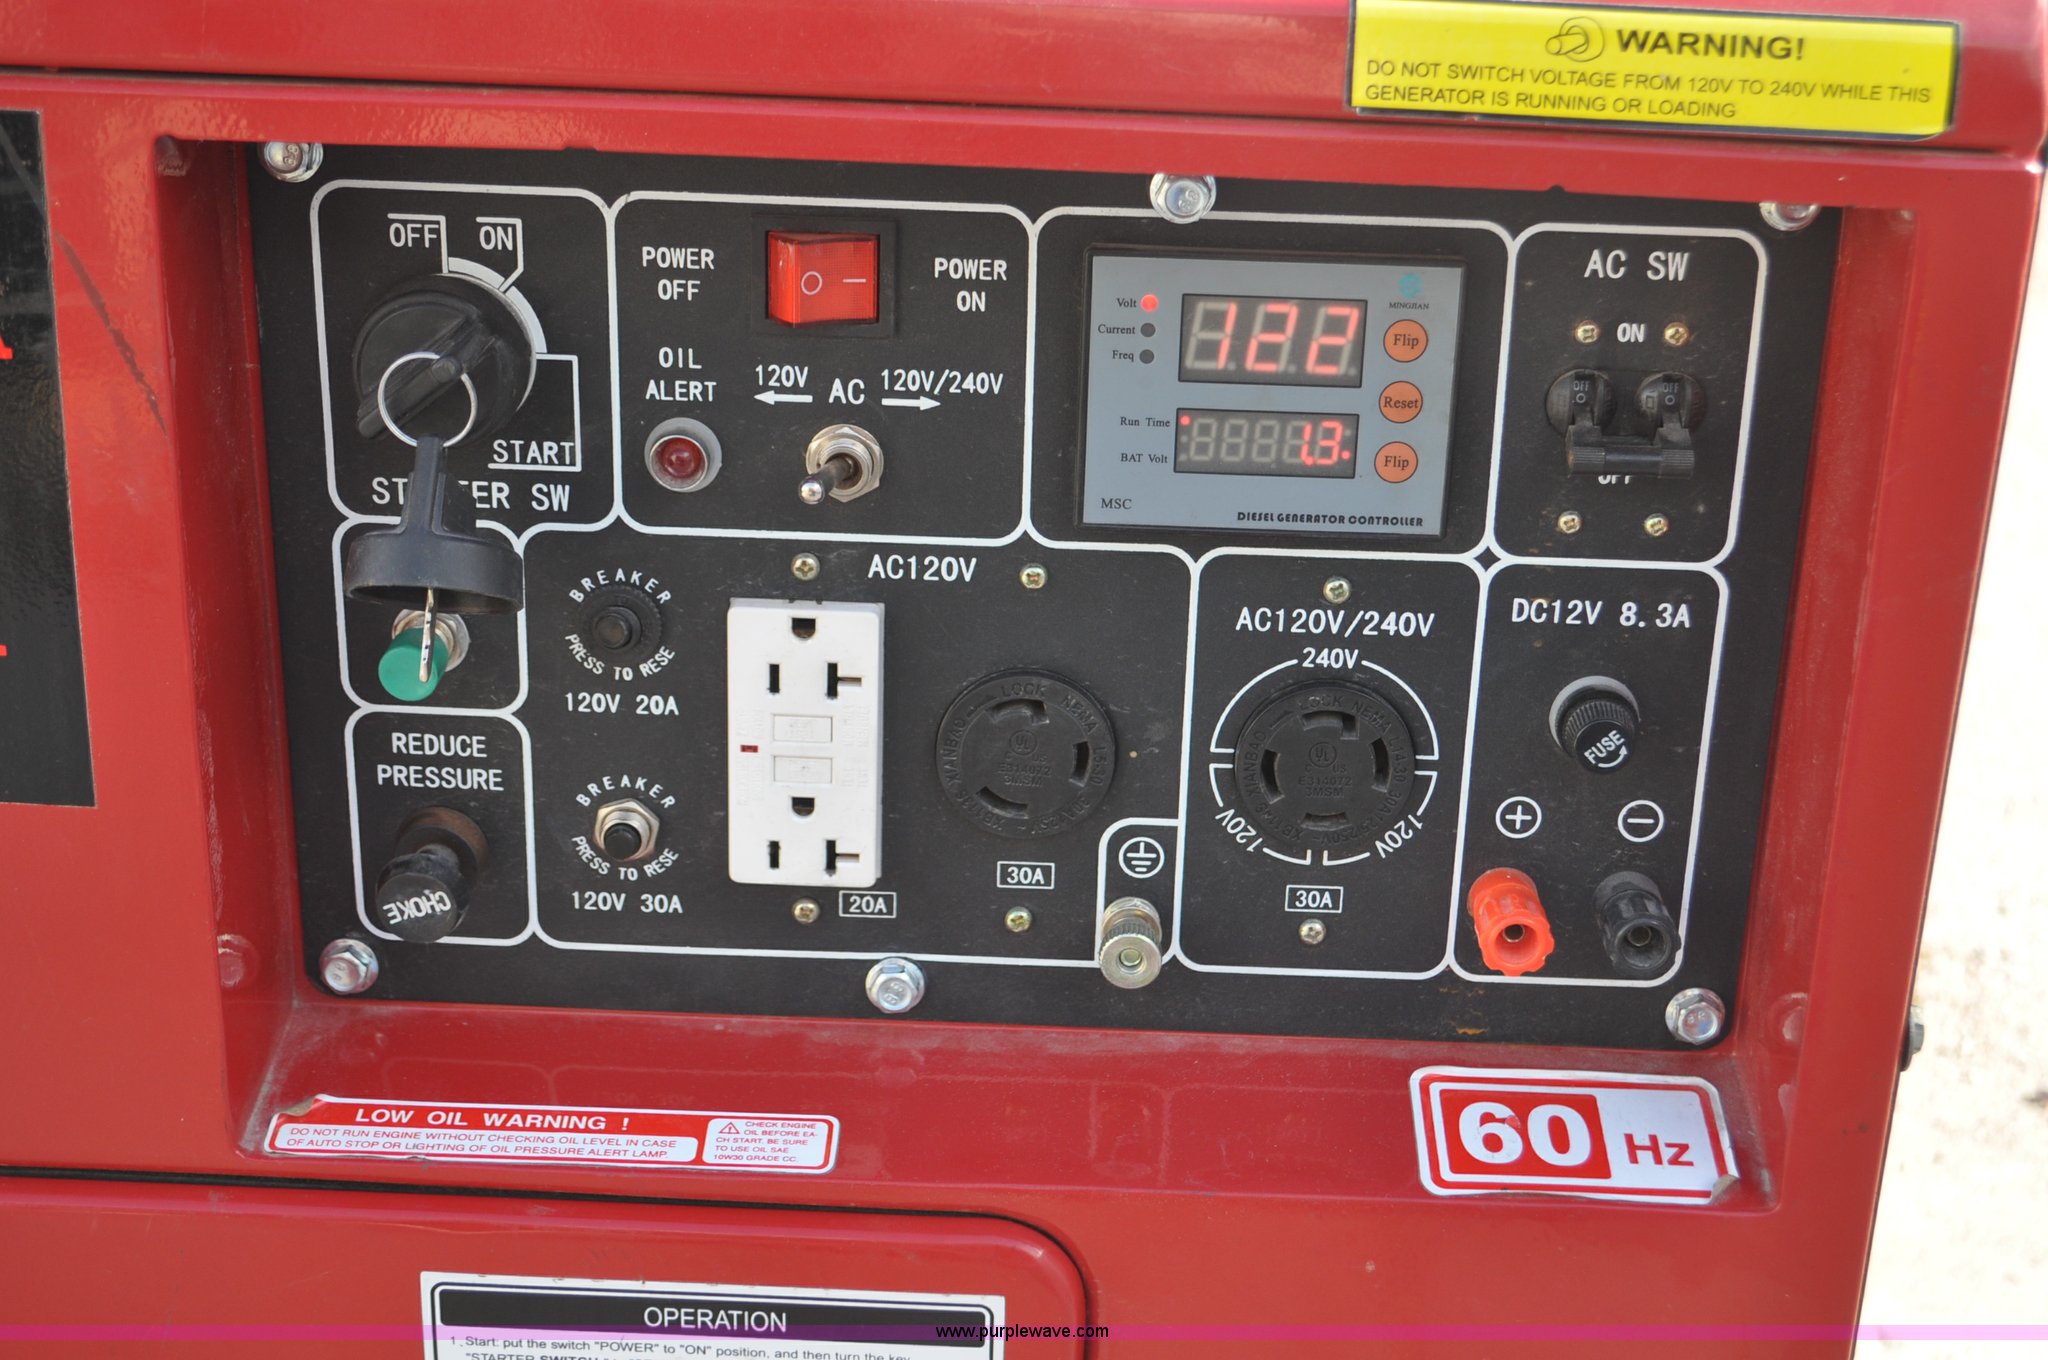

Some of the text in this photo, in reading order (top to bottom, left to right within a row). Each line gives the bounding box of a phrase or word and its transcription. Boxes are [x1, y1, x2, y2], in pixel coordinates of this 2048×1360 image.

[1616, 29, 1806, 61] WARNING!
[1367, 60, 1931, 103] DO NOT SWITCH VOLTAGE FROM 120V TO 240V WHILE THIS
[1365, 84, 1736, 118] GENERATOR IS RUNNING OR LOADING
[389, 223, 439, 248] OFF
[479, 226, 513, 251] ON
[642, 246, 715, 270] POWER
[934, 257, 1008, 281] POWER
[1583, 249, 1691, 282] AC SW
[657, 279, 701, 301] OFF
[956, 290, 986, 312] ON
[1116, 297, 1137, 309] Volt
[1097, 324, 1136, 336] Current
[1216, 302, 1360, 375] 122
[1393, 333, 1419, 349] Flip
[1616, 322, 1647, 343] ON
[658, 346, 702, 370] OIL
[1112, 350, 1135, 364] Freq
[754, 364, 809, 388] 120V
[881, 368, 1003, 396] 120V/240V
[1573, 381, 1591, 391] OFF
[1662, 383, 1680, 393] OFF
[645, 380, 717, 402] ALERT
[828, 378, 865, 405] AC
[1383, 396, 1419, 410] Reset
[1120, 416, 1171, 428] Run Time
[492, 439, 575, 465] START
[1120, 452, 1169, 465] BAT Volt
[1384, 454, 1409, 470] Flip
[371, 477, 570, 513] STER SW
[1100, 497, 1132, 511] MSC
[1237, 511, 1423, 527] DIESEL GENERATOR CONTROLLER
[867, 554, 978, 583] AC120V
[568, 568, 672, 604] BREAKER
[1235, 606, 1436, 638] AC120V/240V
[1511, 597, 1603, 625] DC12V
[565, 634, 676, 681] PRESS TO RESE
[1302, 646, 1359, 670] 240V
[565, 691, 680, 716] 120V 20A
[1000, 682, 1048, 698] LOCK
[1061, 696, 1100, 735] NEMA
[391, 731, 487, 758] REDUCE
[1583, 729, 1626, 764] FUSE
[377, 764, 504, 791] PRESSURE
[575, 774, 676, 809] BREAKER
[1215, 807, 1264, 853] 120V
[1374, 813, 1423, 859] 120V
[571, 835, 680, 881] PRESS TO RESE
[1006, 866, 1045, 885] 30A
[382, 890, 452, 925] CHOKE
[571, 890, 684, 914] 120V 30A
[848, 896, 888, 914] 20A
[1294, 890, 1333, 909] 30A
[355, 1108, 416, 1125] LOW
[427, 1111, 468, 1126] OIL
[483, 1112, 607, 1131] WARNING
[290, 1127, 678, 1148] DO NOT RUN ENGINE WITHOUT CHECKING OIL LEVEL IN CASE
[1458, 1101, 1695, 1167] 60 Hz
[286, 1138, 668, 1159] OF AUTO STOP OR LIGHTING OF OIL PRESSURE ALERT LAMP.
[643, 1307, 787, 1333] OPERATION
[503, 1339, 523, 1350] put
[527, 1339, 547, 1350] the
[551, 1340, 591, 1351] switch
[594, 1341, 659, 1353] "POWER"
[663, 1344, 676, 1354] to
[679, 1344, 712, 1355] "ON"
[716, 1346, 770, 1360] position,
[774, 1349, 799, 1360] and
[803, 1350, 831, 1360] then
